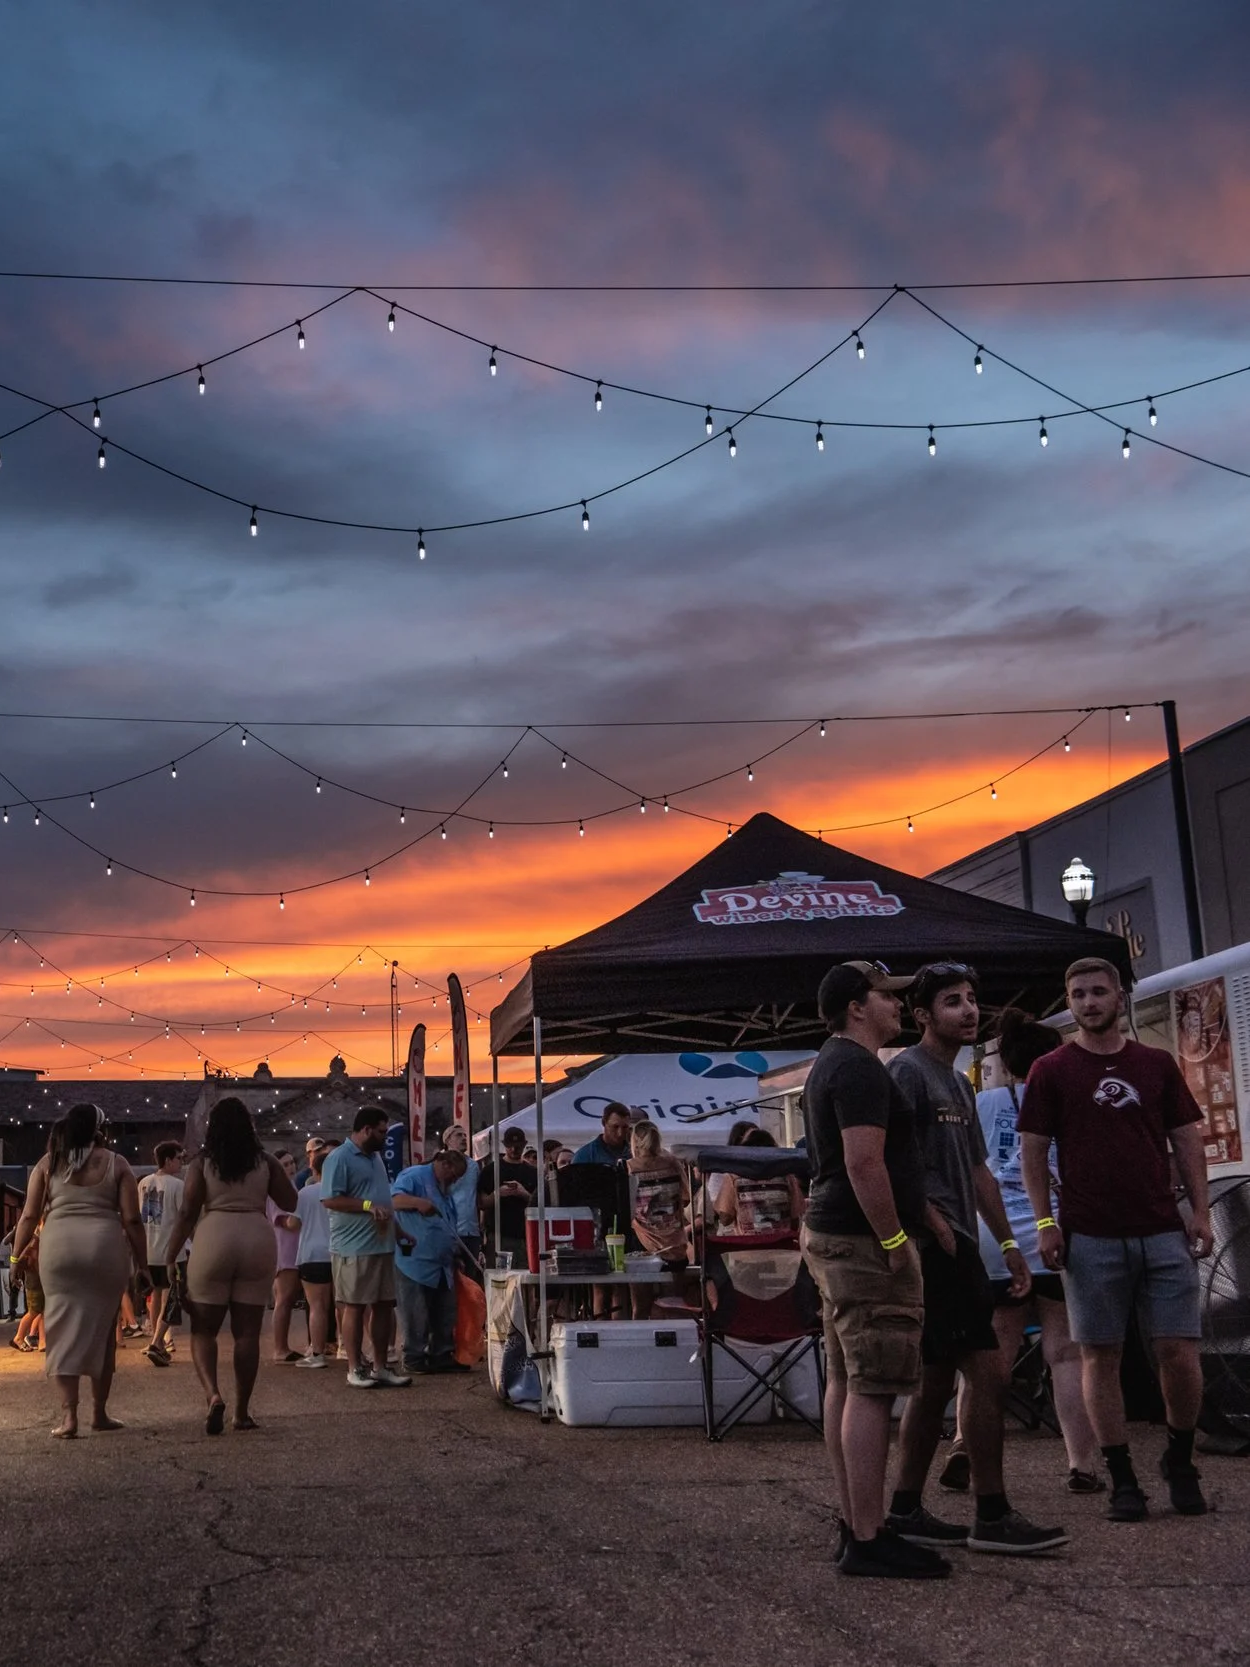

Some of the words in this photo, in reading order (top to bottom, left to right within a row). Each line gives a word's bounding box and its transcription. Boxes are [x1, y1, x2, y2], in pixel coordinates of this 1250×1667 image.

[718, 891, 871, 912] Devine
[711, 910, 784, 925] wines
[787, 907, 811, 920] &
[813, 902, 897, 918] spirits
